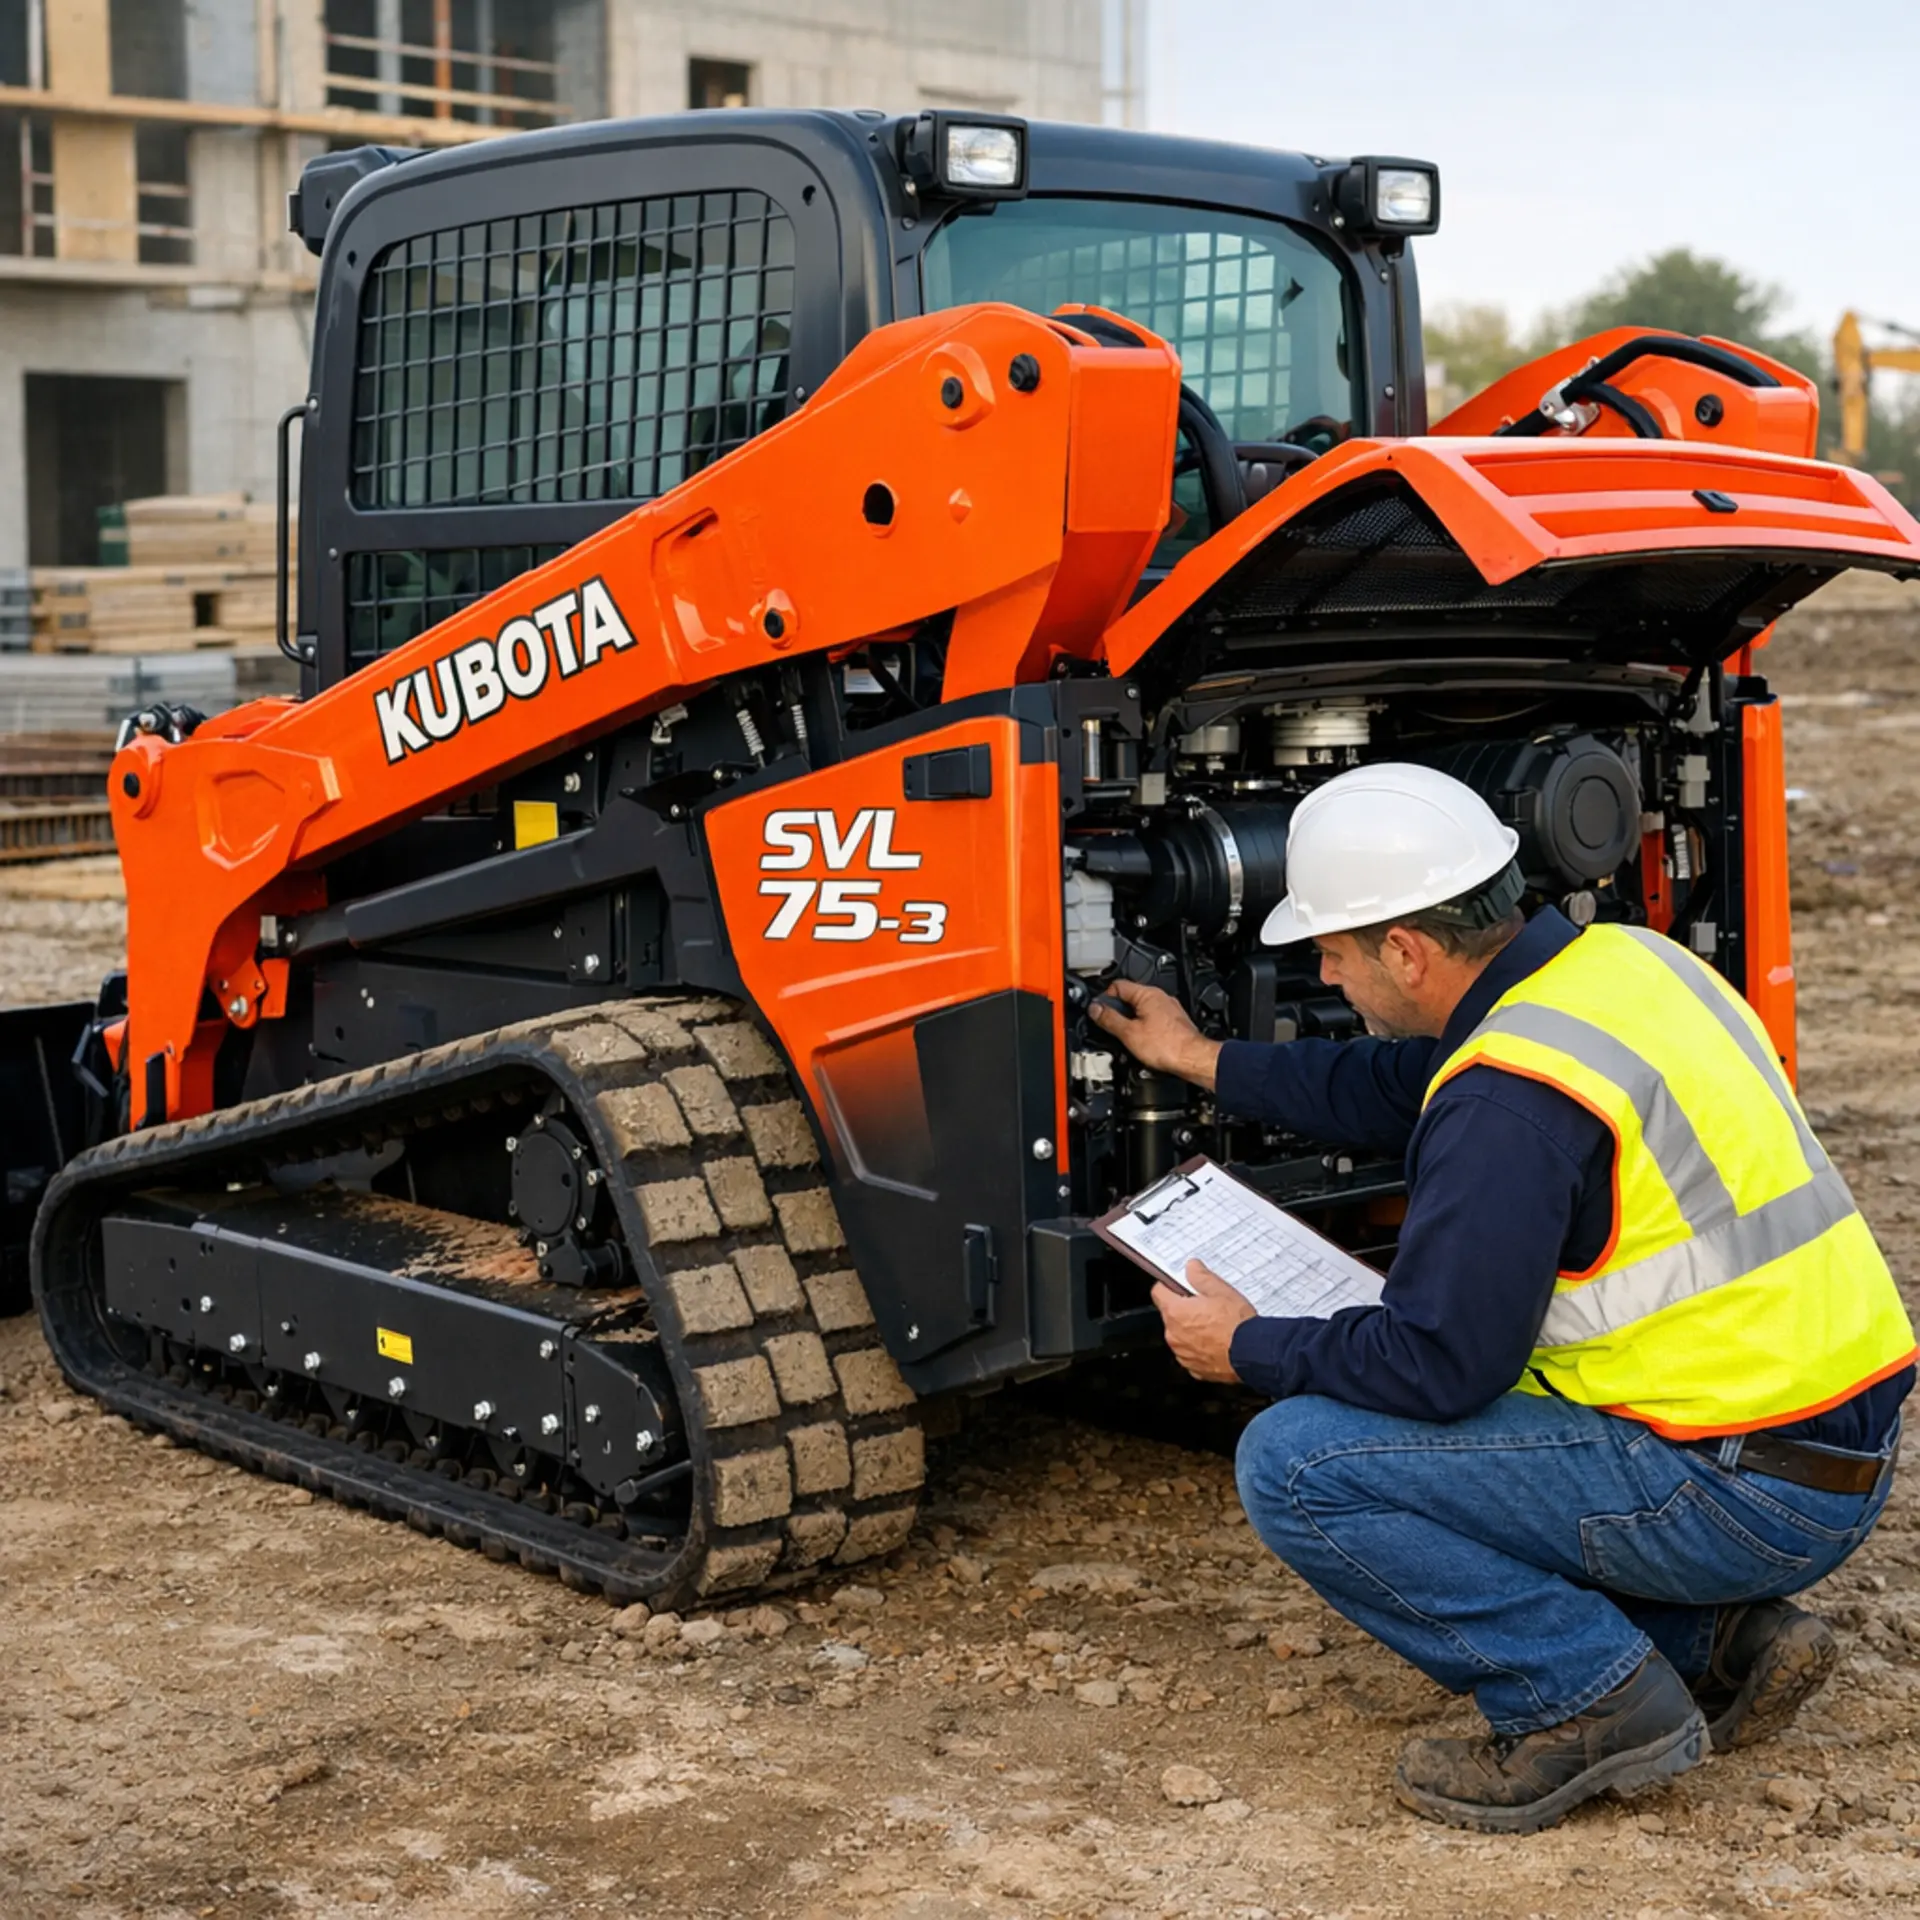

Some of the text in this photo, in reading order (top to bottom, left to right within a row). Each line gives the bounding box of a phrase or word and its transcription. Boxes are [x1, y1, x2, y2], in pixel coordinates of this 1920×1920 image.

[373, 575, 638, 765] KUBOTA
[760, 808, 923, 871] SVL
[758, 879, 948, 944] 75-3
